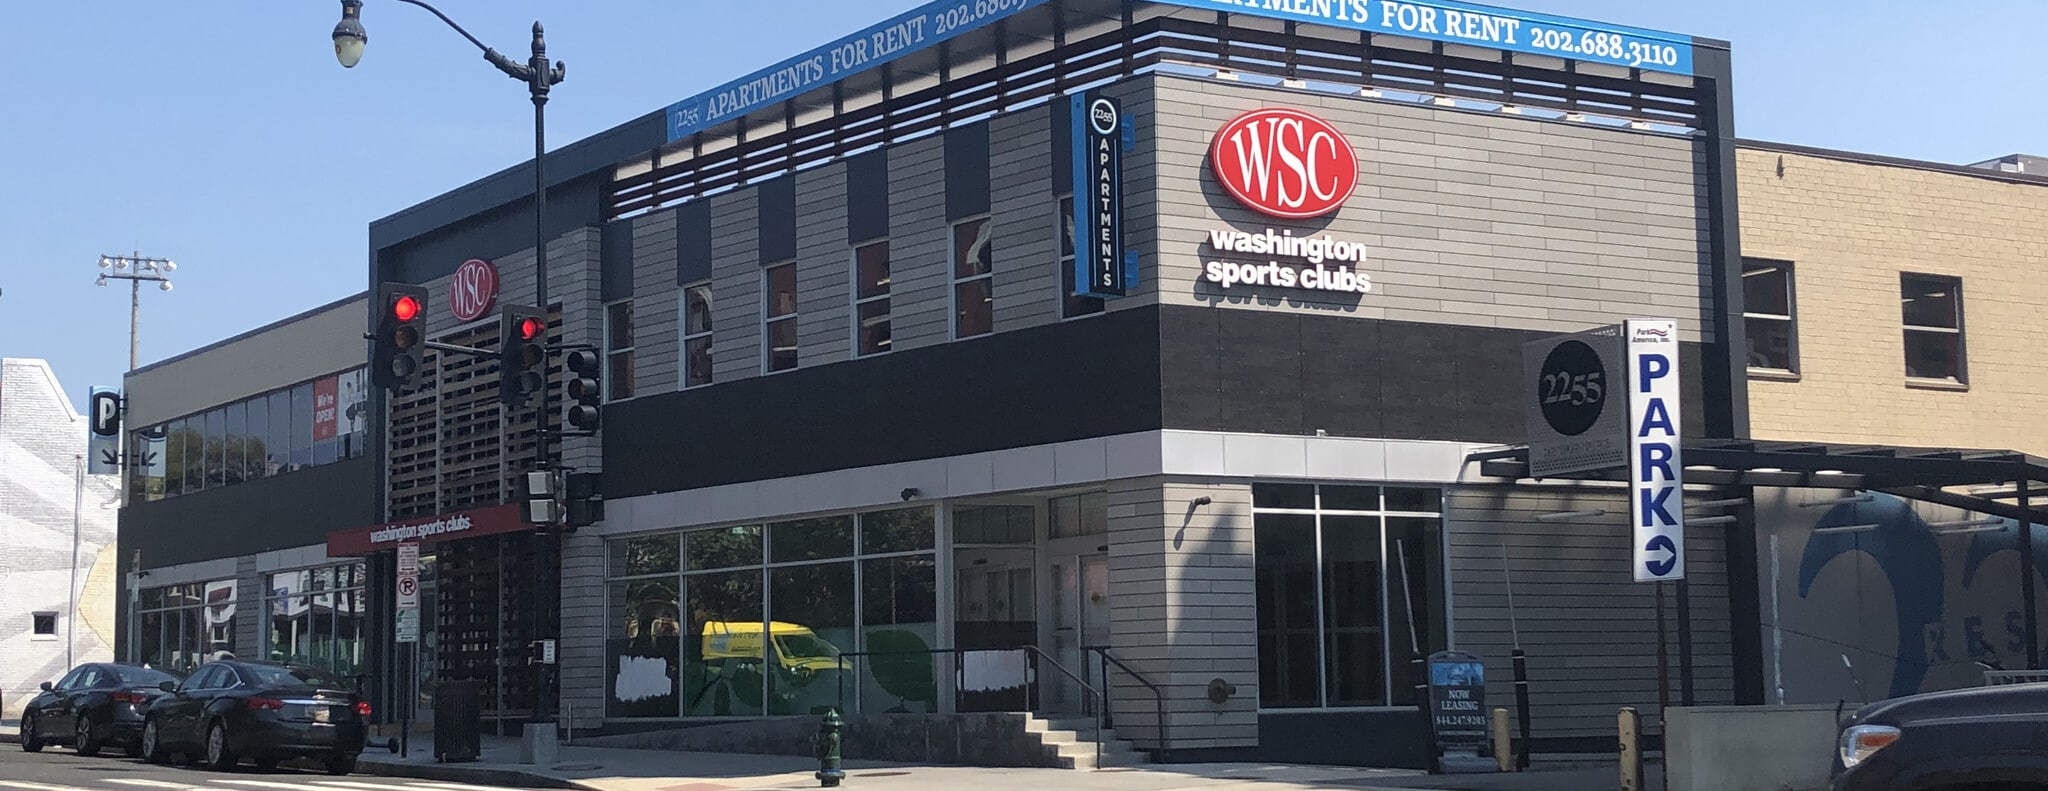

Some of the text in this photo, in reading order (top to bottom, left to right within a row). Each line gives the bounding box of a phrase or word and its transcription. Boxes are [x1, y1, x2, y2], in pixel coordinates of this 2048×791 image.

[1381, 1, 1439, 34] FOR
[1443, 10, 1520, 44] RENT
[1530, 27, 1677, 66] 202.688.3110
[678, 109, 698, 127] 2255
[706, 54, 824, 121] APARTMENTS
[831, 39, 868, 75] FOR
[872, 15, 926, 58] RENT
[1095, 108, 1113, 123] 2255
[1230, 117, 1338, 208] WSC
[1100, 138, 1112, 286] APARTMENTS
[1210, 228, 1367, 264] washington
[453, 263, 487, 315] WSC
[1206, 261, 1372, 293] sports clubs
[1543, 371, 1601, 406] 2255
[100, 397, 116, 430] P
[1638, 354, 1678, 528] PARK
[370, 514, 470, 543] washington sports clubs
[1441, 700, 1479, 710] LEASING
[1448, 689, 1470, 699] NOW
